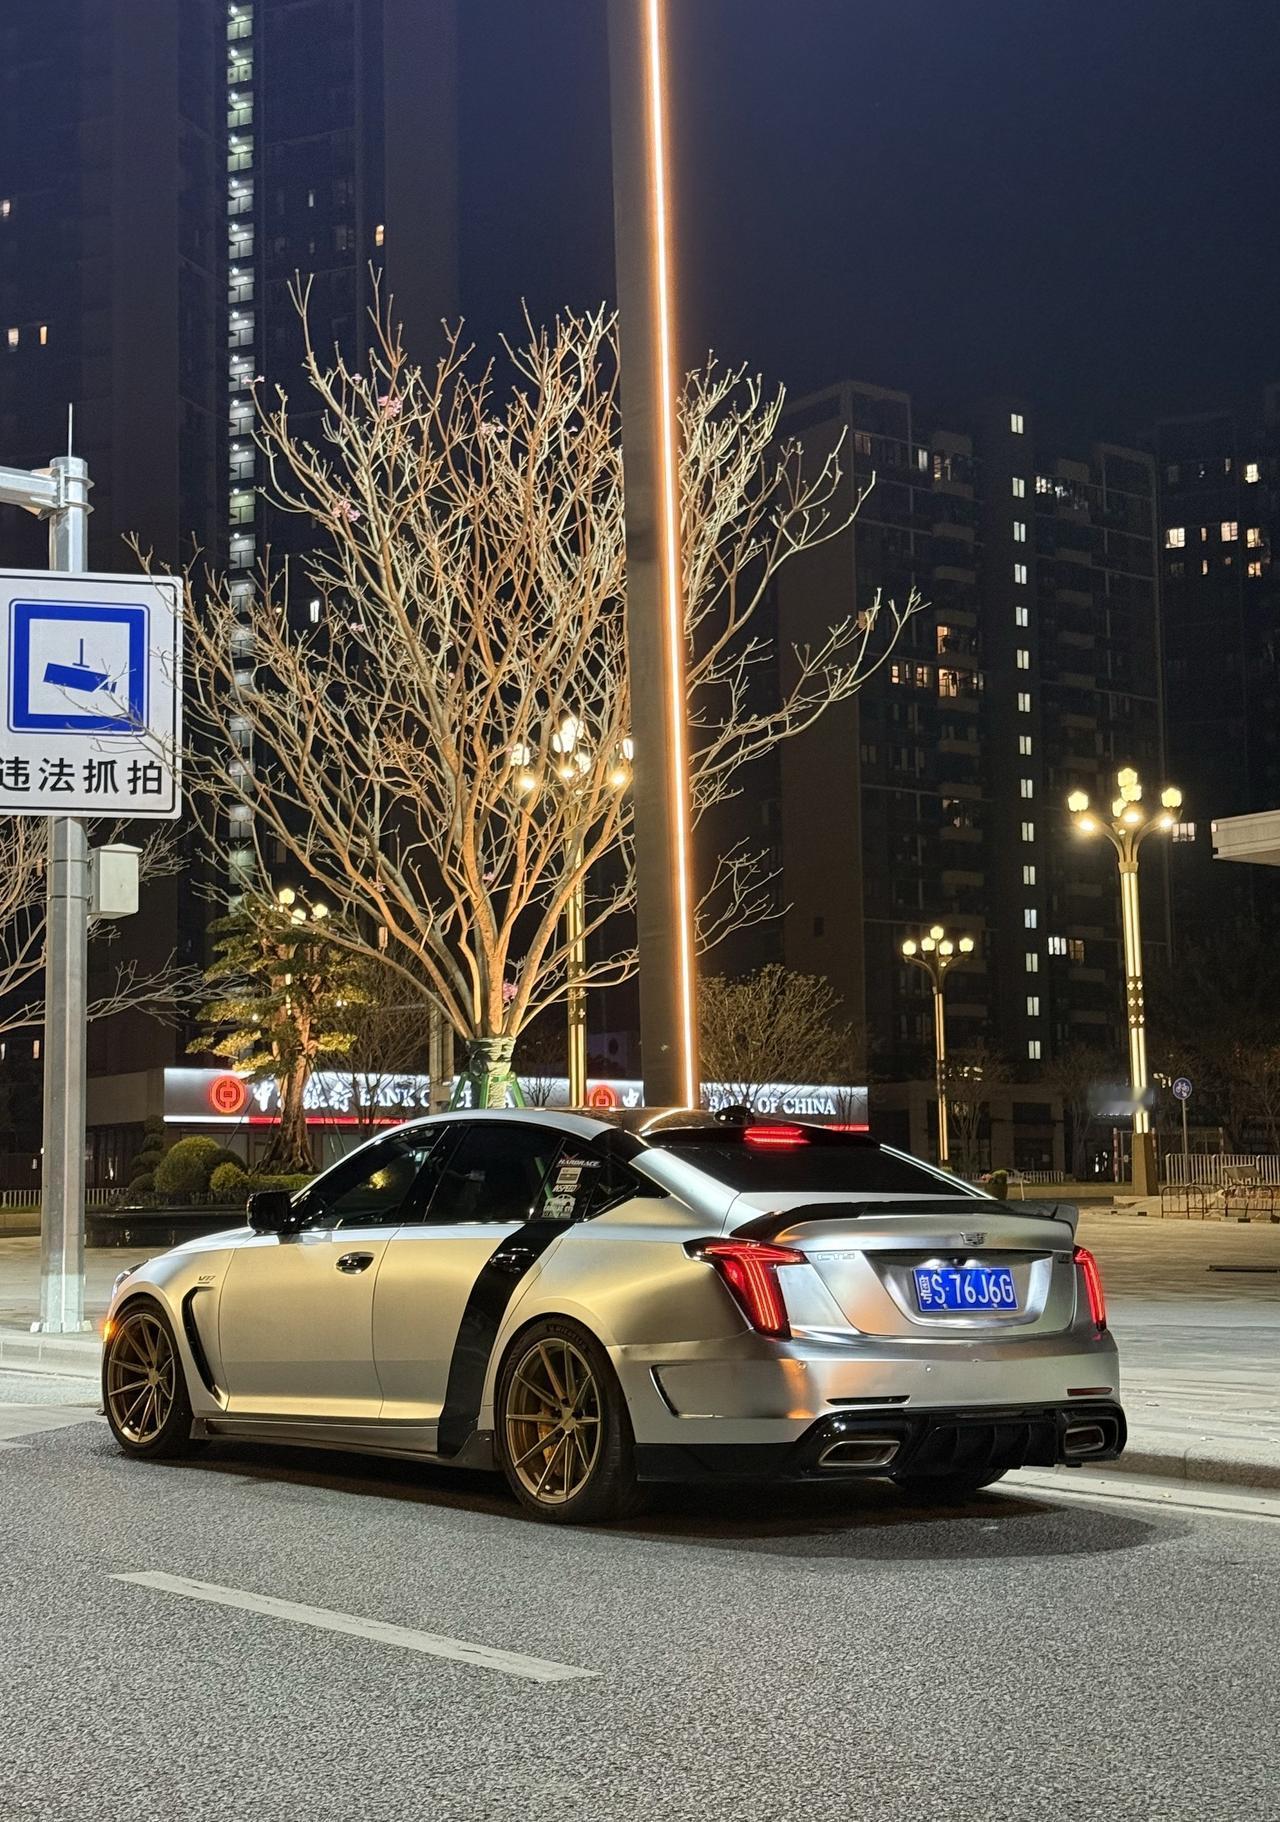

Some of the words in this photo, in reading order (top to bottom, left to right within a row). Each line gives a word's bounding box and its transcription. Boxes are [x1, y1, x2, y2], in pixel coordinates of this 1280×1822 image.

[0, 756, 162, 795] 违法抓拍
[252, 1079, 353, 1112] 中银行
[757, 1096, 780, 1114] OF
[782, 1097, 837, 1115] CHINA
